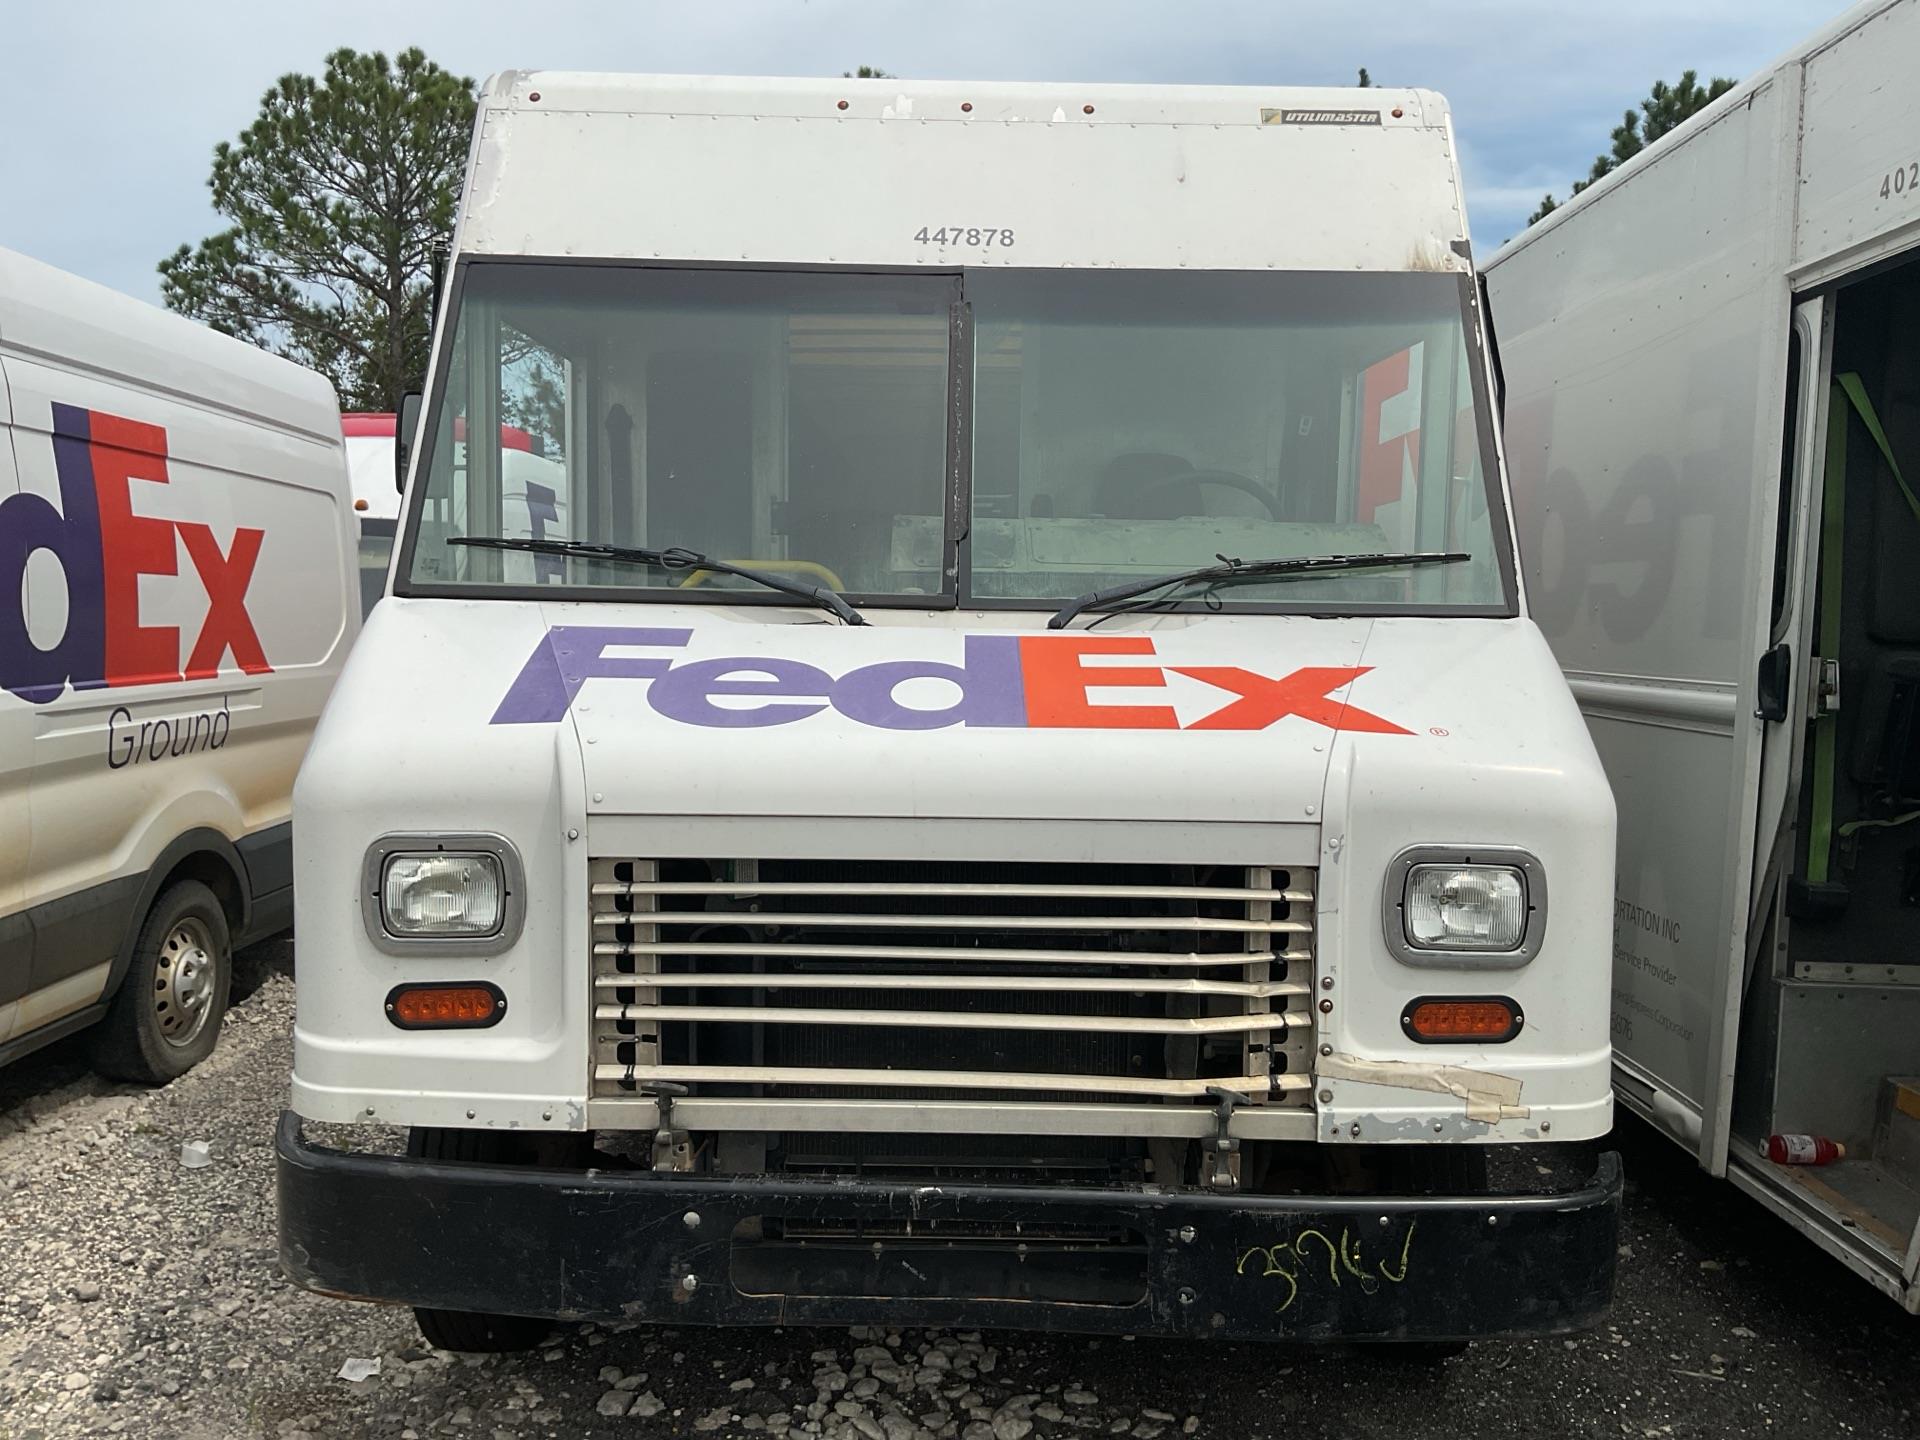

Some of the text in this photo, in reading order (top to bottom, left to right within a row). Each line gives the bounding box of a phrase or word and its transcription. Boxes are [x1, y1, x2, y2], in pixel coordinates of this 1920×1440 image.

[1285, 111, 1378, 123] UTILIMASTER
[1879, 162, 1919, 199] 402
[914, 227, 1014, 247] 447878
[489, 626, 1420, 736] FedEx
[108, 694, 231, 769] Ground
[1661, 917, 1681, 943] INC
[1643, 957, 1677, 986] Provider
